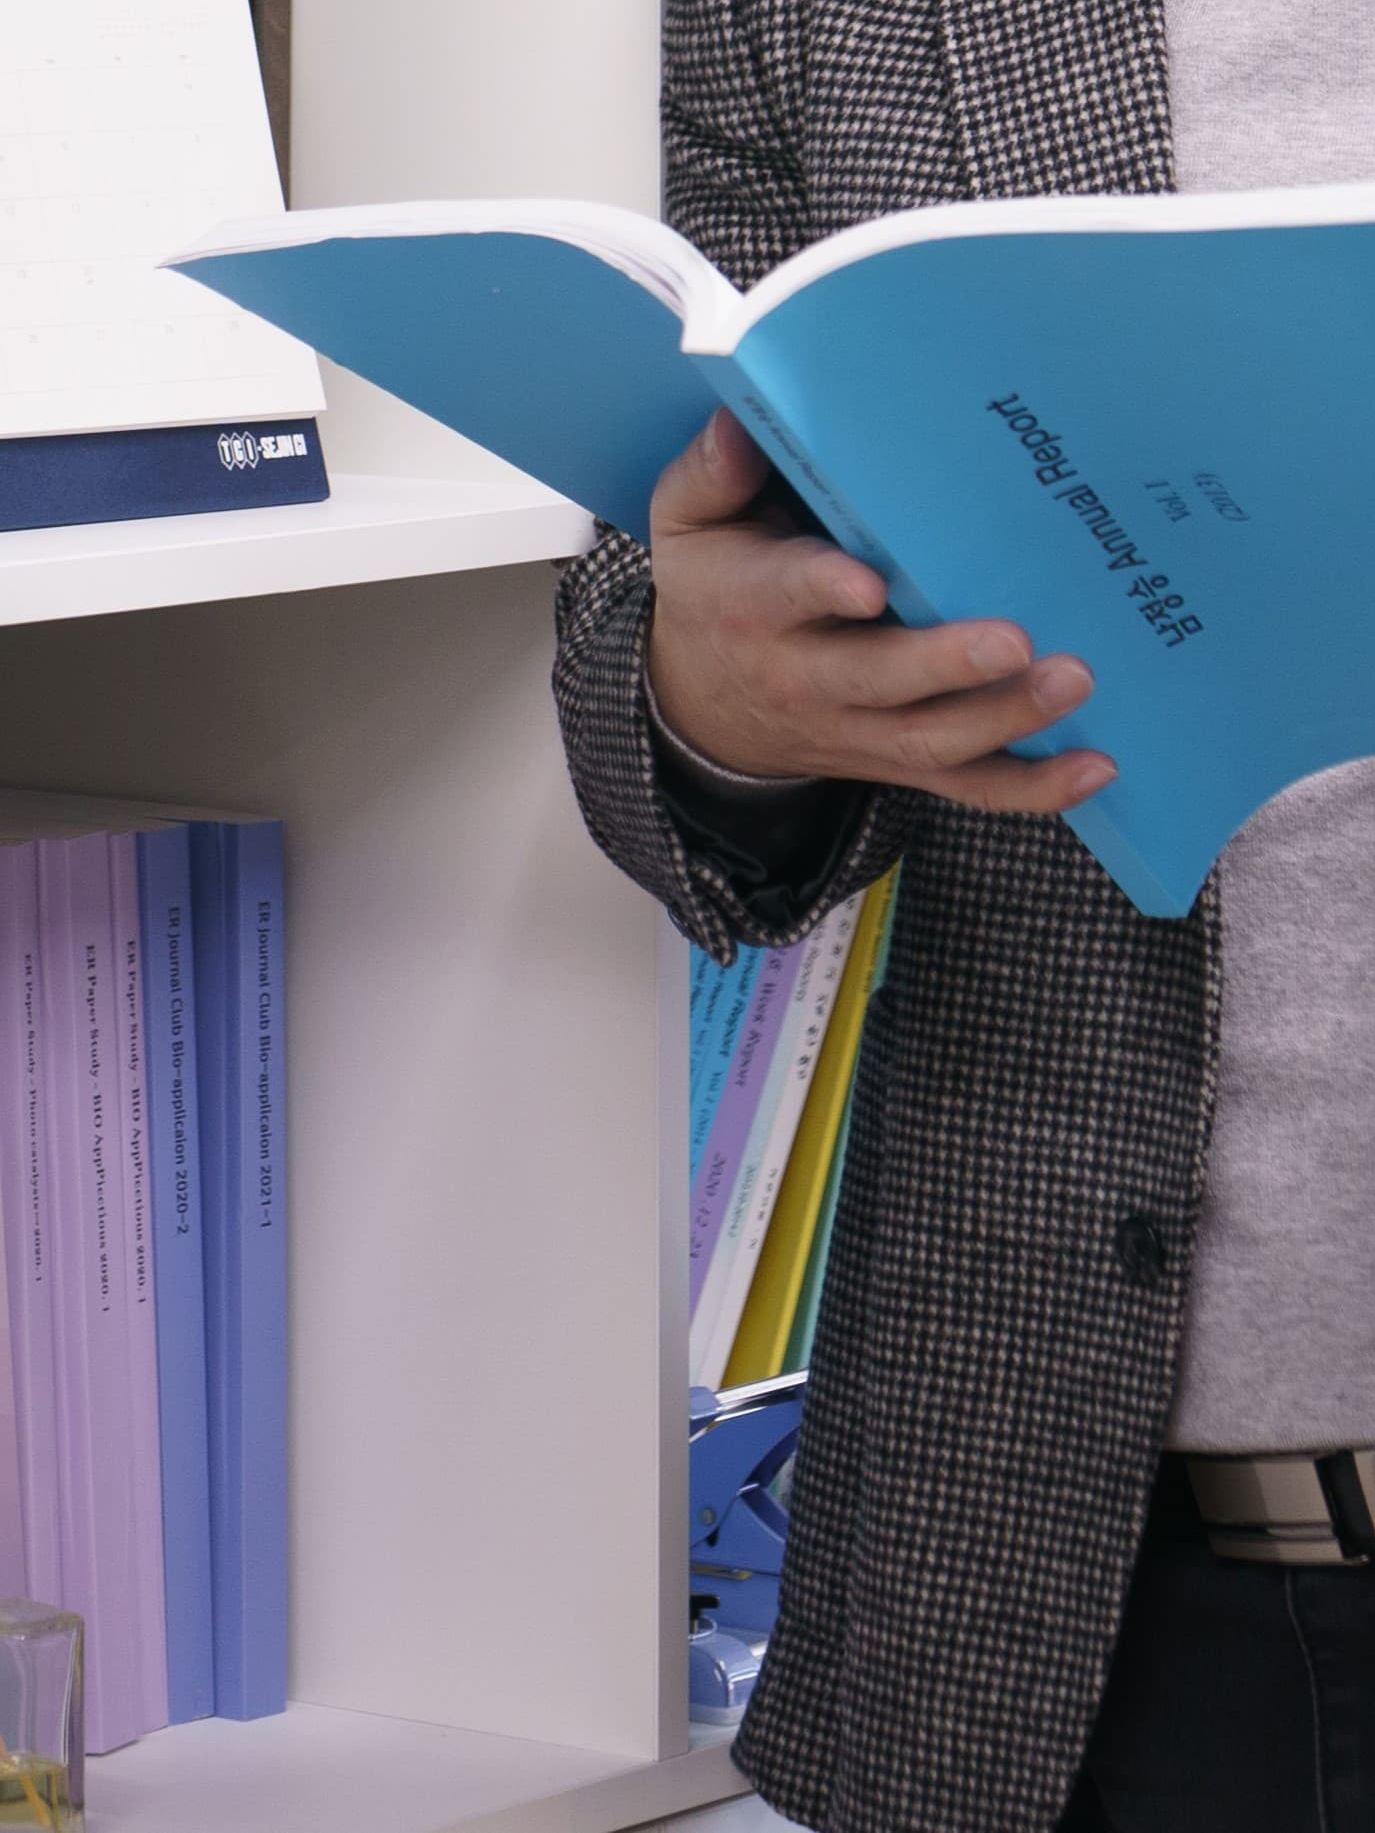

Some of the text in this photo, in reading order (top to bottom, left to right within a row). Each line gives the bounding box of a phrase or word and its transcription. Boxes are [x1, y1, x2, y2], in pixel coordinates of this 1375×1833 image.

[985, 391, 1204, 649] 남정승 Annual Report
[167, 906, 182, 929] ER
[256, 900, 271, 923] ER
[85, 943, 97, 971] ER
[126, 940, 137, 966] ER
[167, 932, 183, 994] Journal
[256, 926, 272, 988] Journal
[24, 981, 34, 1026] Paper
[86, 974, 98, 1025] Paper
[126, 970, 138, 1019] Paper
[169, 998, 184, 1036] Club
[258, 992, 272, 1030] Club
[27, 1029, 38, 1075] Study
[88, 1028, 102, 1078] Study
[128, 1022, 140, 1072] Study
[28, 1088, 39, 1138] Photo
[92, 1093, 104, 1129] BIO
[130, 1087, 142, 1123] BIO
[175, 1169, 189, 1235] 2020-2
[259, 1164, 273, 1229] 2021-1
